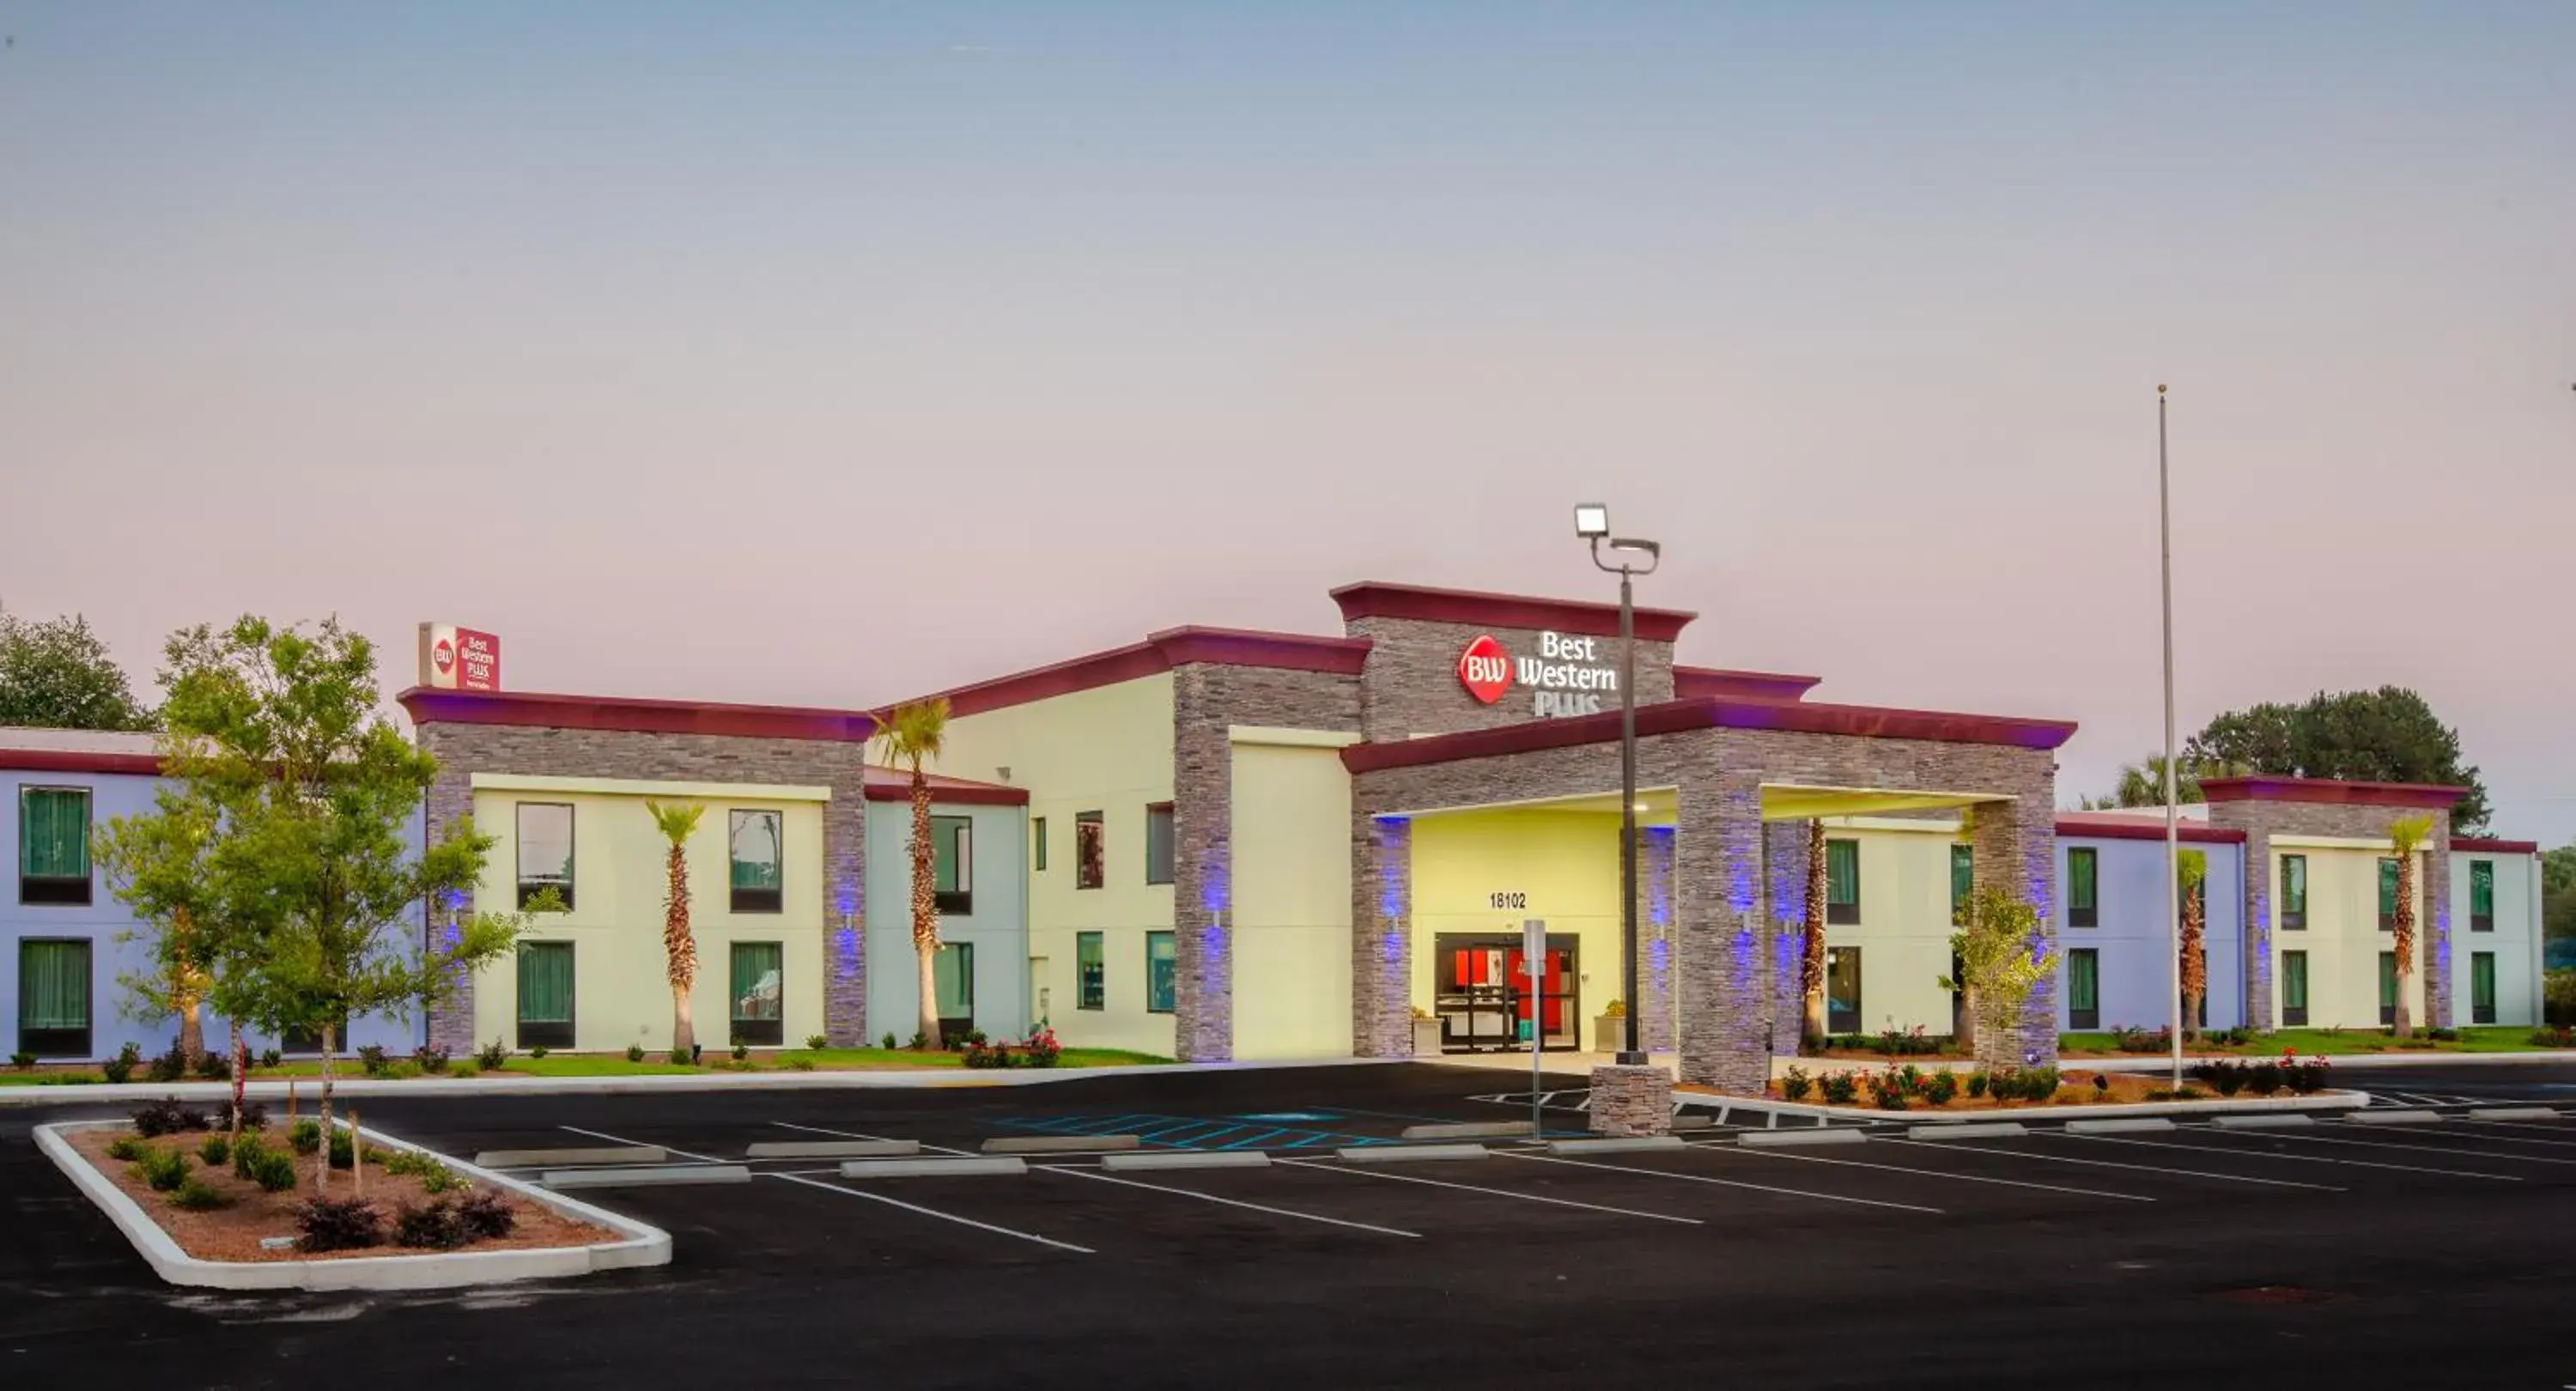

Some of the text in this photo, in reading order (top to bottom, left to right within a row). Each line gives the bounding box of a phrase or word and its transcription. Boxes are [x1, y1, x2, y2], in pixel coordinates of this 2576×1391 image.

[1542, 630, 1595, 660] Best
[1467, 656, 1506, 683] BW
[1517, 657, 1617, 690] Western
[1534, 691, 1600, 716] PLUS
[1491, 892, 1525, 909] 18102
